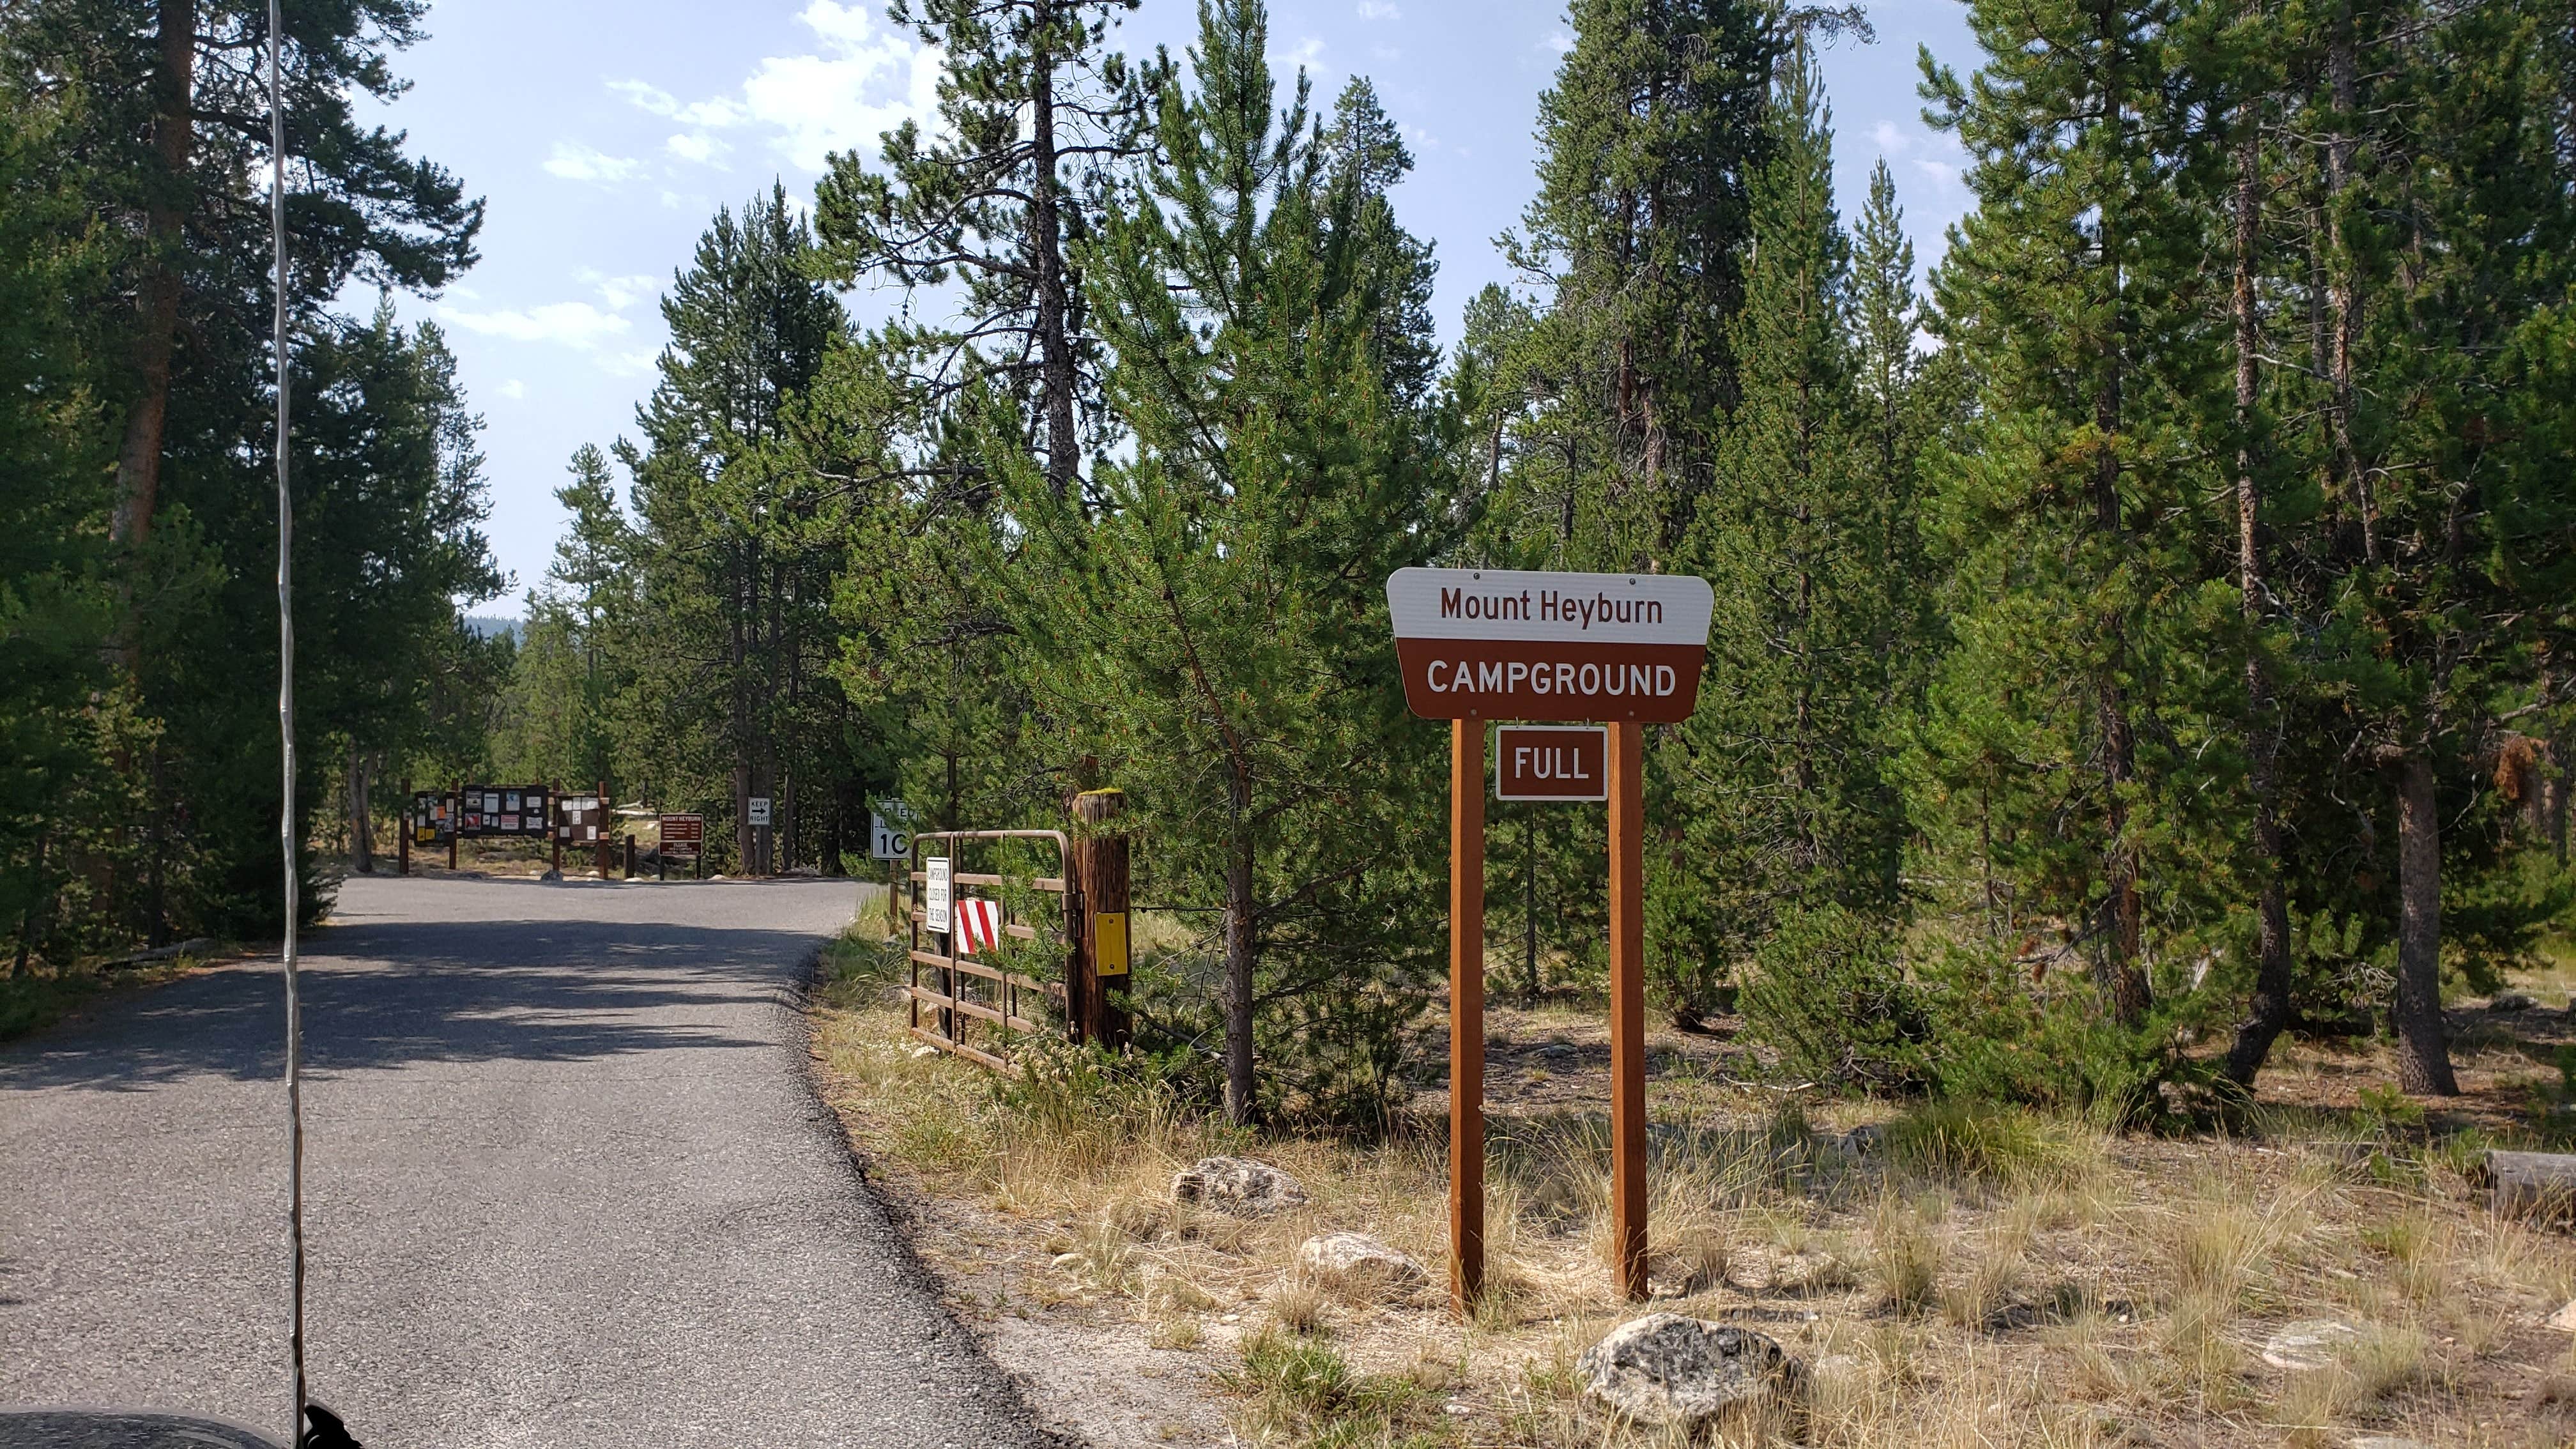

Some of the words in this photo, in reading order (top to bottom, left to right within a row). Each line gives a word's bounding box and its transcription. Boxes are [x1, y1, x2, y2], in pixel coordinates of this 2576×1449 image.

[1441, 587, 1531, 621] Mount
[1540, 590, 1662, 630] Heyburn
[1427, 659, 1676, 697] CAMPGROUND
[1515, 747, 1590, 779] FULL
[877, 808, 915, 817] PED
[928, 867, 947, 881] CAMPGROUND
[929, 887, 940, 901] CLOSED
[935, 908, 947, 923] SEASON
